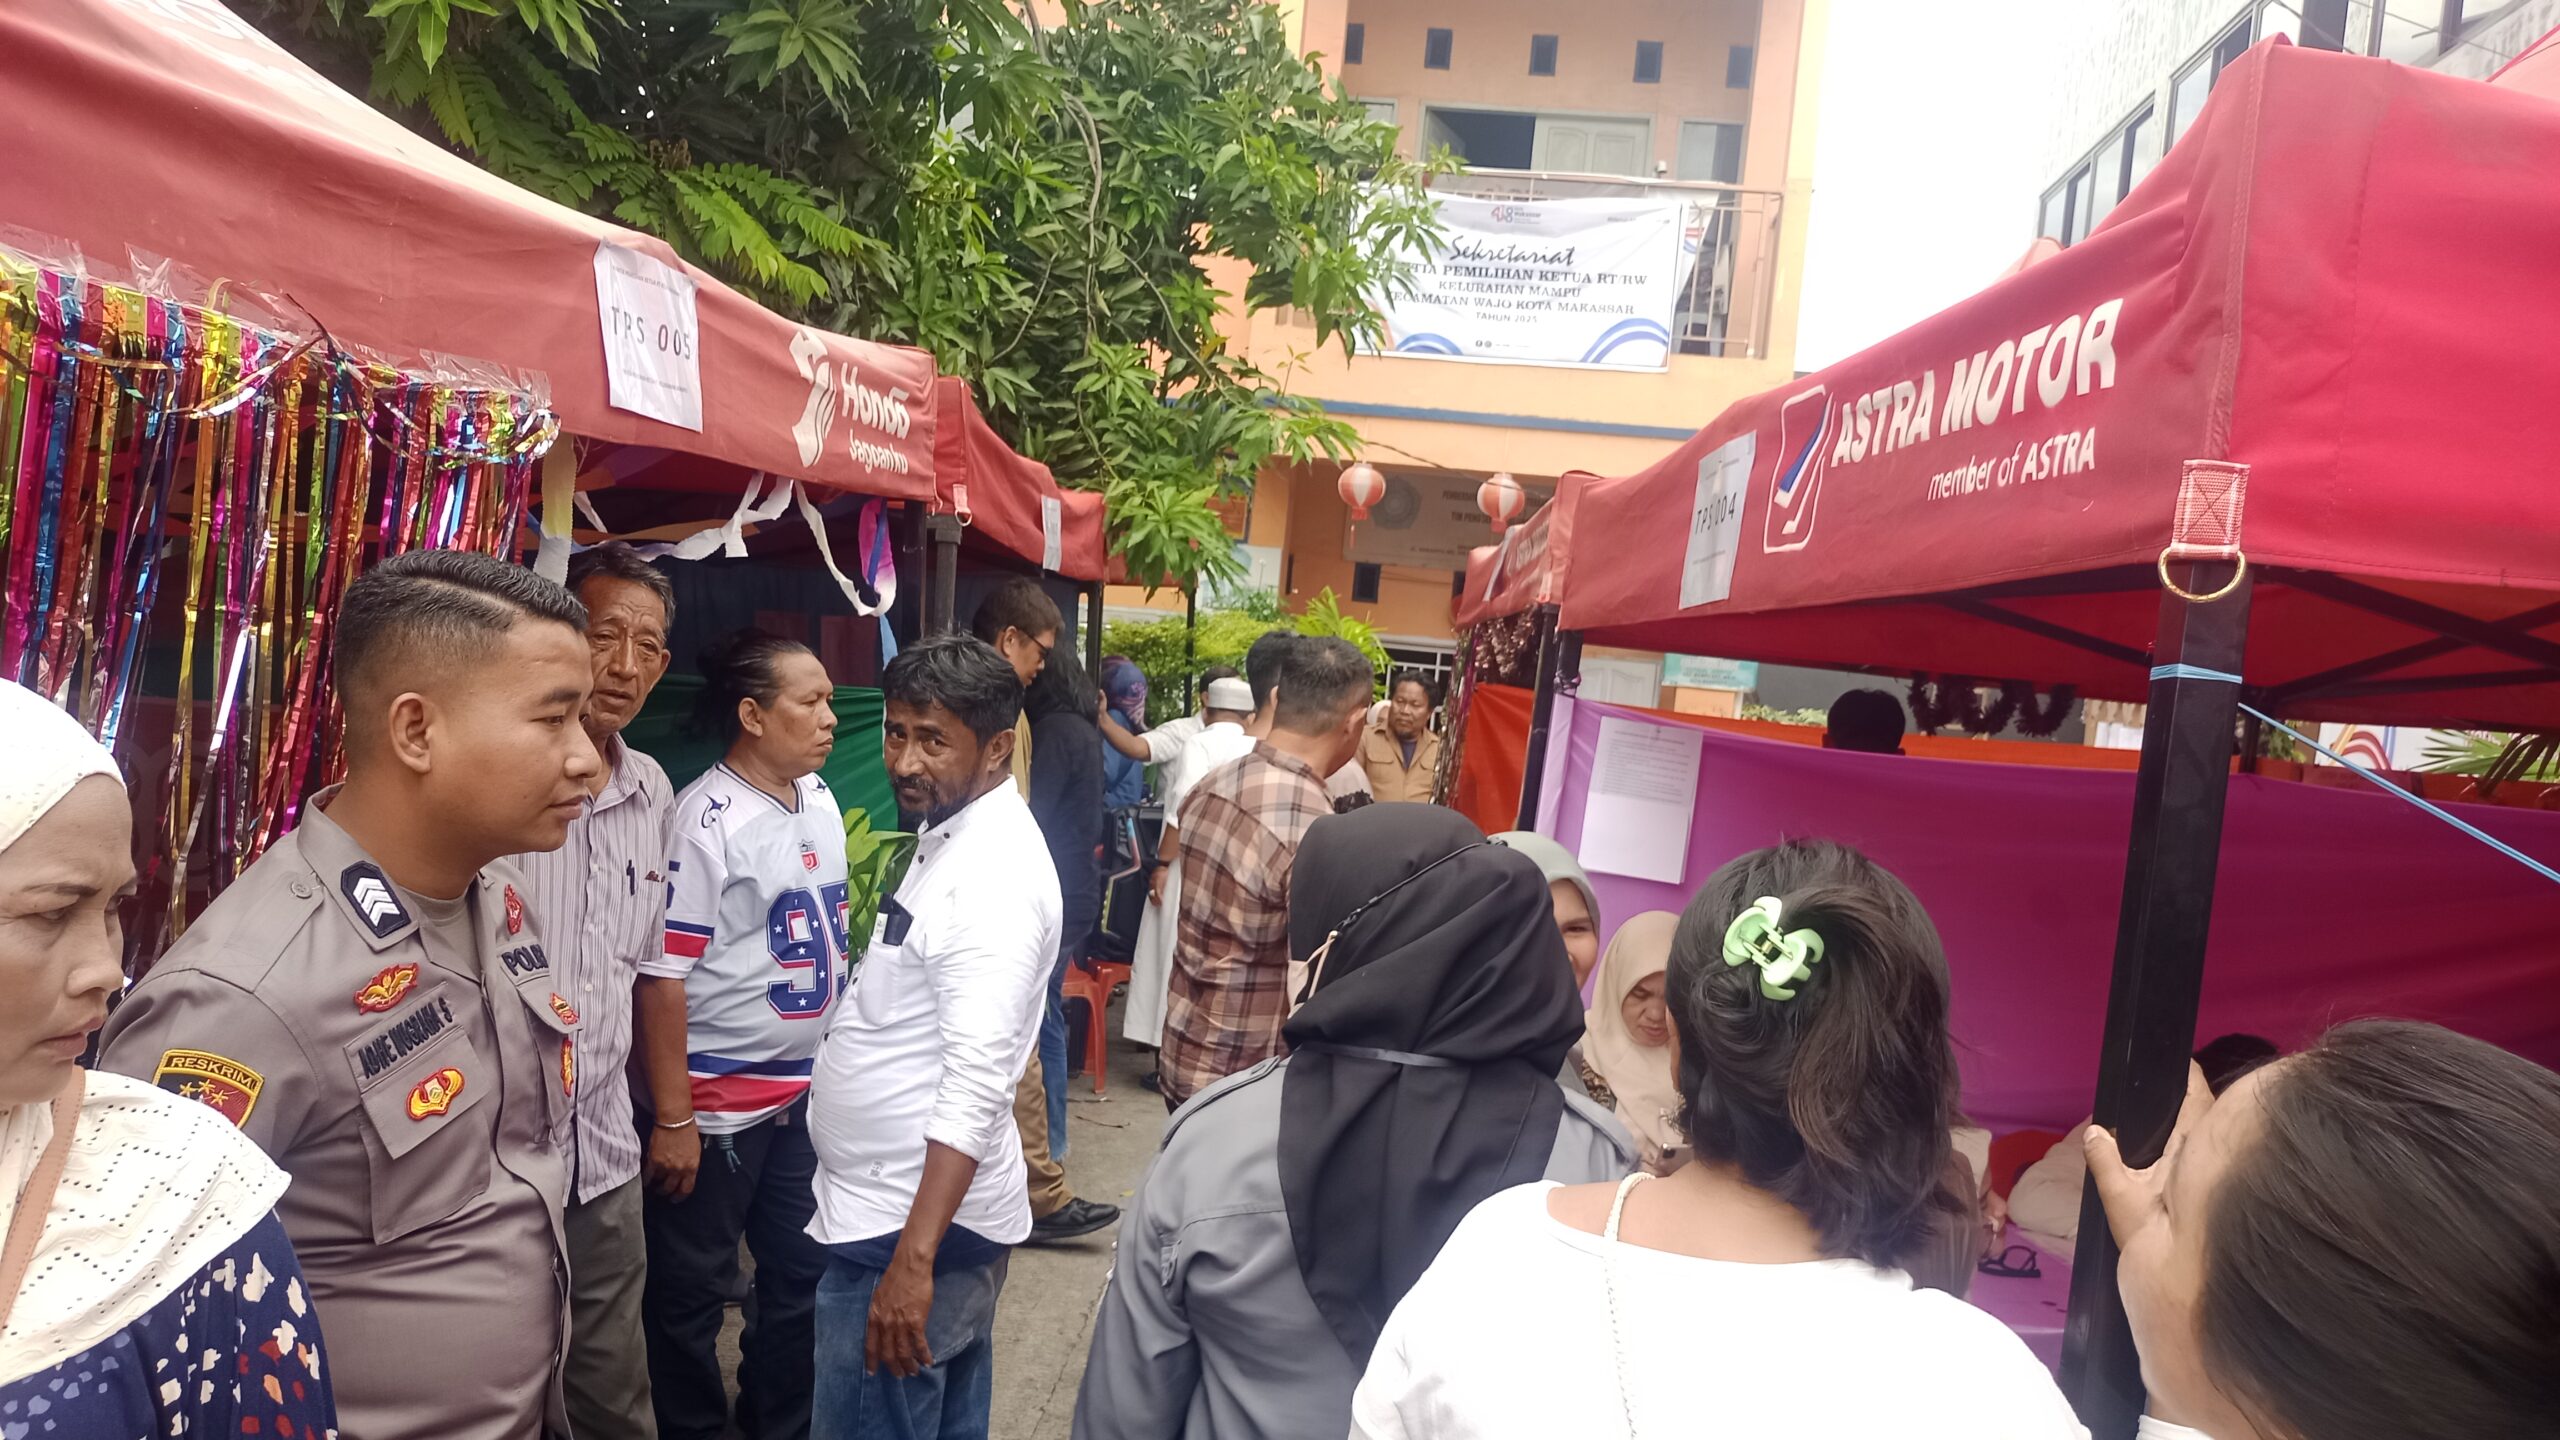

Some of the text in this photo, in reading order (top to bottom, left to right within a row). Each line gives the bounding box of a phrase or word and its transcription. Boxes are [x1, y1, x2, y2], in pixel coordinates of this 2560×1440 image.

[1450, 235, 1575, 266] Sekretariat
[1439, 281, 1582, 298] KELURAHAN MAMPU
[1443, 265, 1534, 281] PEMILIHAN
[1539, 270, 1593, 284] KETUA
[1390, 291, 1635, 315] ECAMATAN WAJO KOTA MAKASSAR
[1476, 312, 1511, 322] TAHUN
[611, 305, 691, 361] TPS 005
[1831, 298, 2123, 467] ASTRA MOTOR
[841, 362, 911, 440] Honda
[849, 428, 909, 475] Jagoanku
[1928, 427, 2096, 501] member of ASTRA
[171, 1057, 254, 1090] RESKRIM
